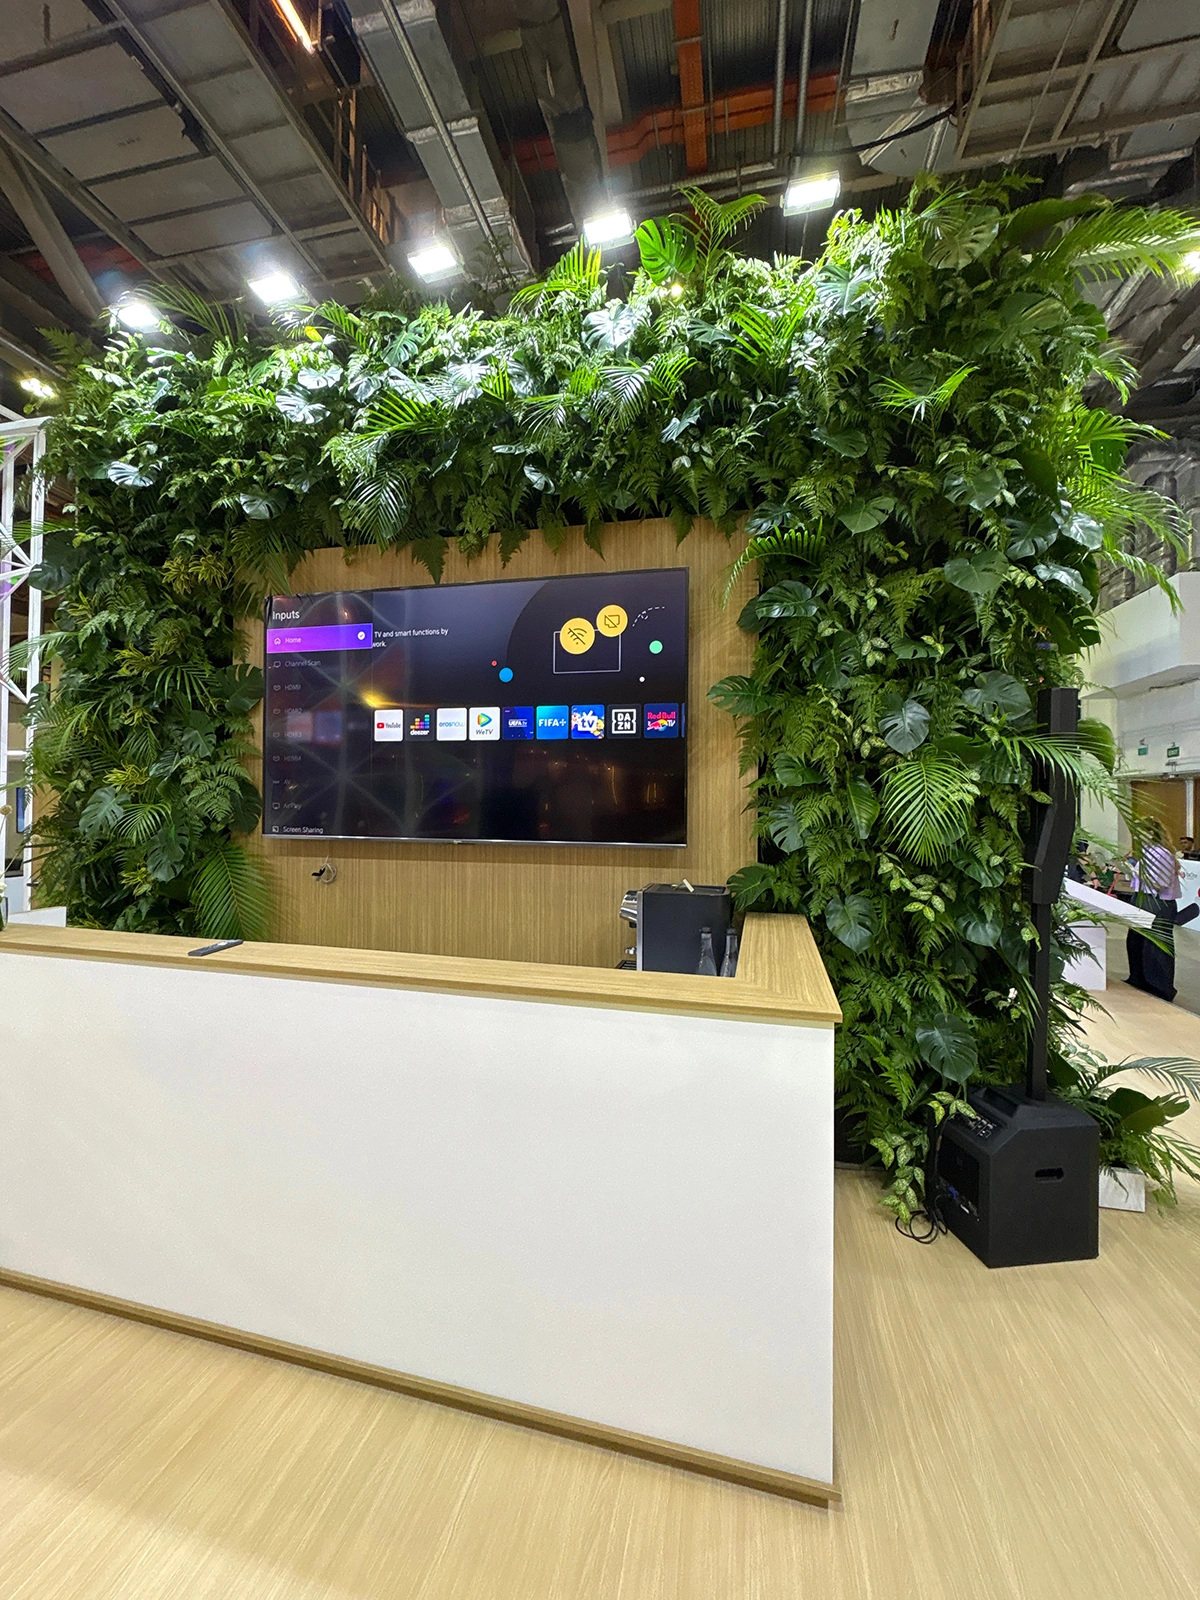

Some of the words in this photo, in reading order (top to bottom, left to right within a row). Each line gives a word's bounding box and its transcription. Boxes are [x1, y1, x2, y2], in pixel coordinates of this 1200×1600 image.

[272, 610, 300, 621] Inputs
[394, 629, 412, 637] smart
[412, 628, 440, 636] functions
[440, 627, 449, 636] by
[647, 711, 661, 719] Red
[661, 711, 676, 719] Bull
[538, 718, 567, 727] FIFA+
[475, 728, 494, 736] WeTV
[302, 826, 324, 834] Sharing
